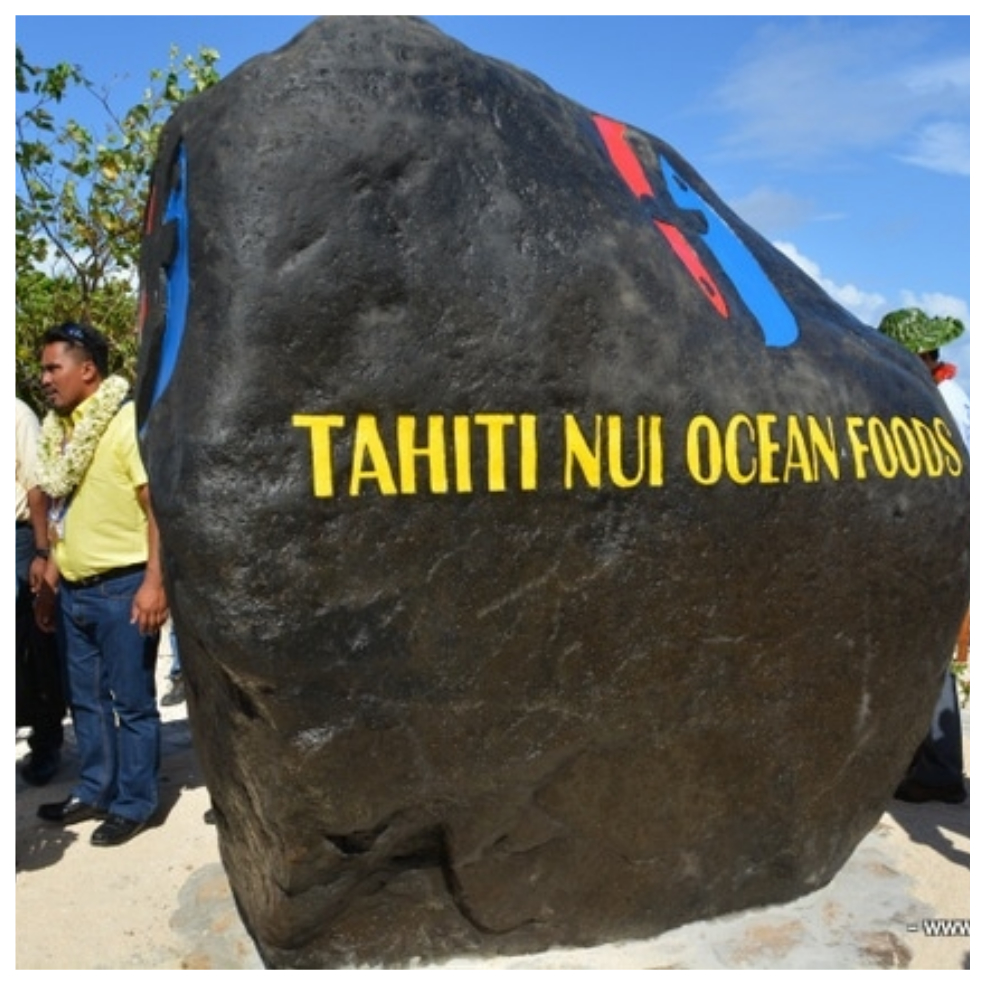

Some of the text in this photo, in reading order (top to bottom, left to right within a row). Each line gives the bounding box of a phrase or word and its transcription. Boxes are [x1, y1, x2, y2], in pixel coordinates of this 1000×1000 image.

[292, 413, 962, 497] TAHITI NUI OCEAN FOODS
